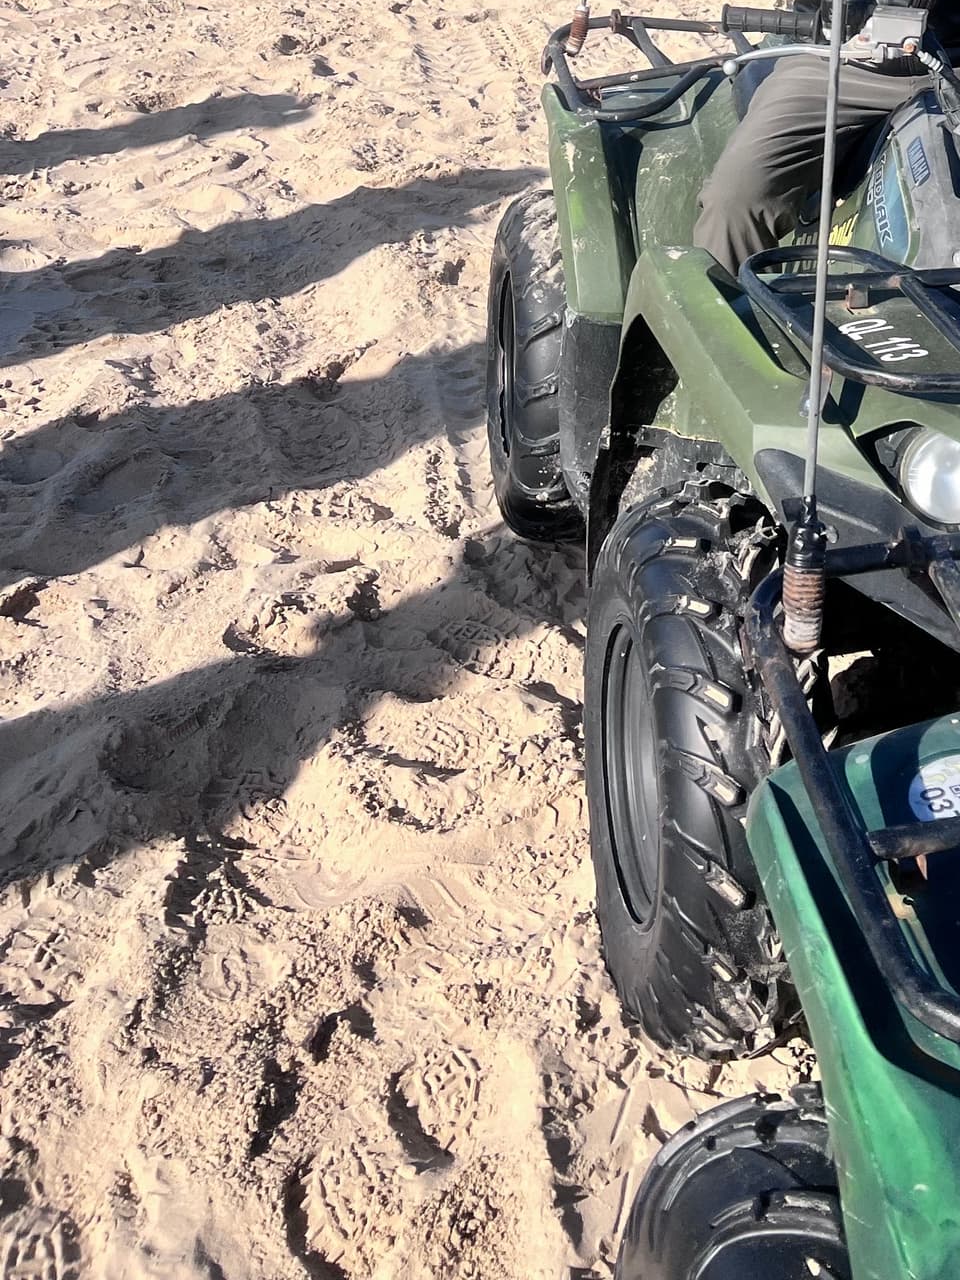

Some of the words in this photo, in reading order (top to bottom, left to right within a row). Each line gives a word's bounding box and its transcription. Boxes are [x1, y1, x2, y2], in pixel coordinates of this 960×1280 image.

[910, 140, 930, 185] YAMAHA
[838, 318, 895, 341] QL
[864, 336, 929, 362] 113
[920, 786, 960, 817] 03
